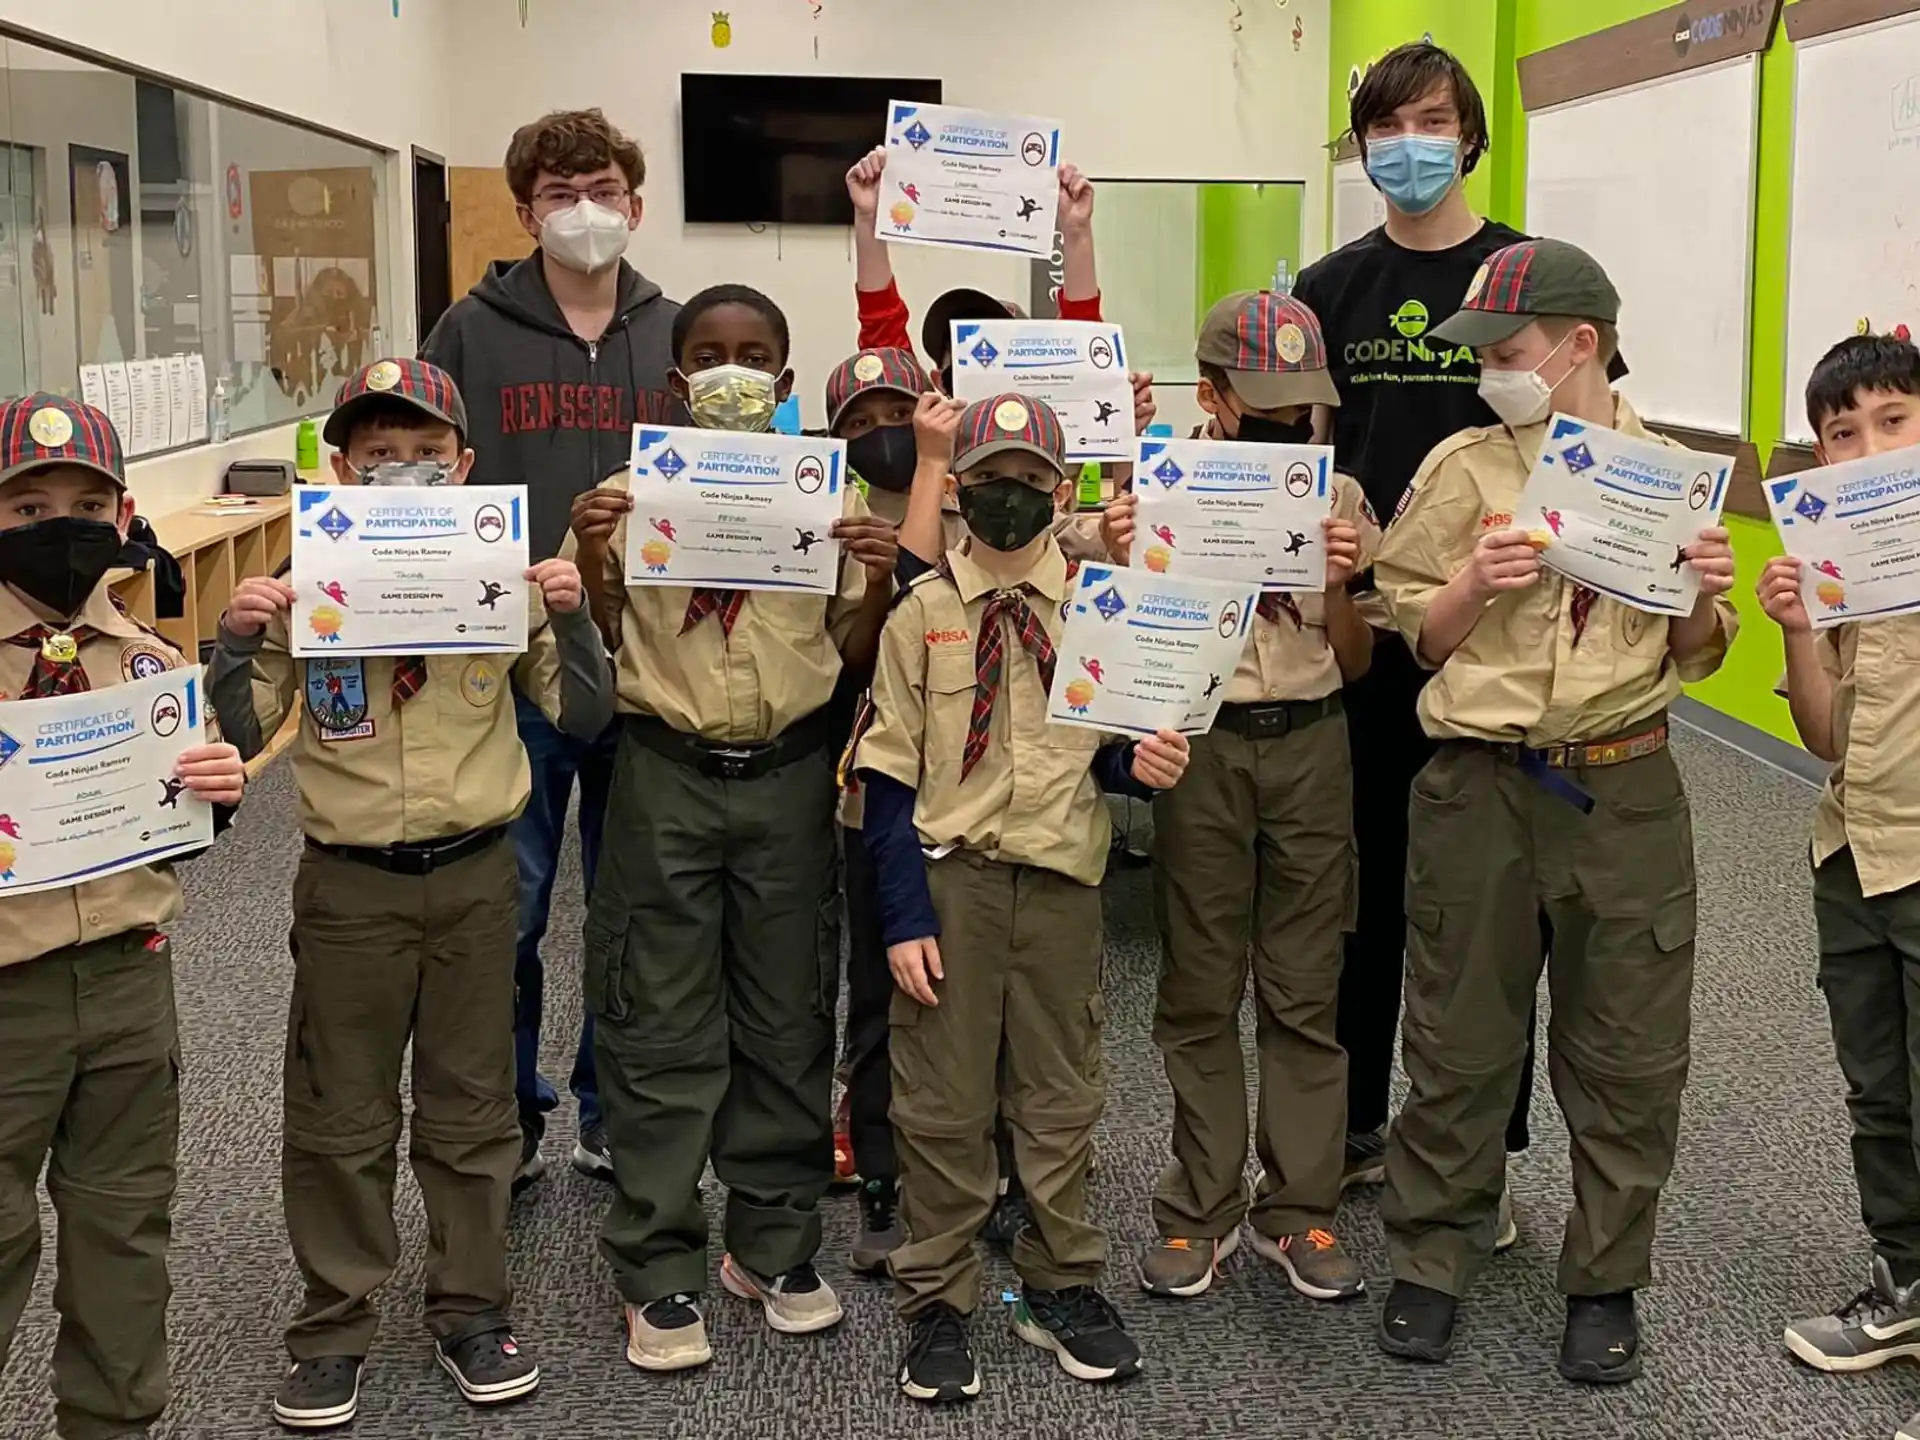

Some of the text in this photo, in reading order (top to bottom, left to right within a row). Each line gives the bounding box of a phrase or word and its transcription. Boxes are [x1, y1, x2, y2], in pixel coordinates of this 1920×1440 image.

[943, 124, 1008, 139] CERTIFICATE OF
[939, 134, 1009, 150] PARTICIPATION
[1010, 338, 1073, 348] CERTIFICATE OF
[1008, 348, 1077, 357] PARTICIPATION
[1344, 339, 1404, 365] CODE
[701, 450, 779, 465] CERTIFICATE OF
[697, 461, 780, 476] PARTICIPATION
[1196, 460, 1268, 471] CERTIFICATE OF
[1612, 454, 1683, 480] CERTIFICATE OF
[1193, 472, 1271, 483] PARTICIPATION
[1605, 465, 1682, 492] PARTICIPATION
[1836, 468, 1914, 494] CERTIFICATE OF
[700, 490, 720, 499] Code
[720, 492, 744, 501] Ninjas
[1836, 478, 1920, 505] PARTICIPATION
[1197, 498, 1214, 506] Code
[1600, 493, 1620, 506] Code
[368, 506, 453, 518] CERTIFICATE OF
[366, 518, 457, 529] PARTICIPATION
[1850, 520, 1870, 531] Code
[1894, 510, 1920, 521] Ramse
[706, 532, 724, 540] GAME
[372, 548, 452, 558] Code Ninjas Ramsey
[1593, 536, 1612, 548] GAME
[1612, 541, 1636, 555] DESIGN
[1636, 548, 1648, 557] PIN
[1870, 560, 1889, 568] GAME
[381, 592, 443, 600] GAME DESIGN PIN
[1141, 593, 1210, 610] CERTIFICATE OF
[1136, 604, 1210, 621] PARTICIPATION
[942, 630, 969, 641] BSA
[1135, 634, 1154, 644] Code
[1133, 678, 1152, 686] GAME
[1152, 680, 1175, 688] DESIGN
[38, 707, 131, 735] CERTIFICATE OF
[35, 719, 136, 749] PARTICIPATION
[45, 768, 69, 780] Code
[70, 762, 99, 777] Ninjas
[100, 755, 131, 770] Ramsey
[59, 804, 125, 826] GAME DESIGN PIN
